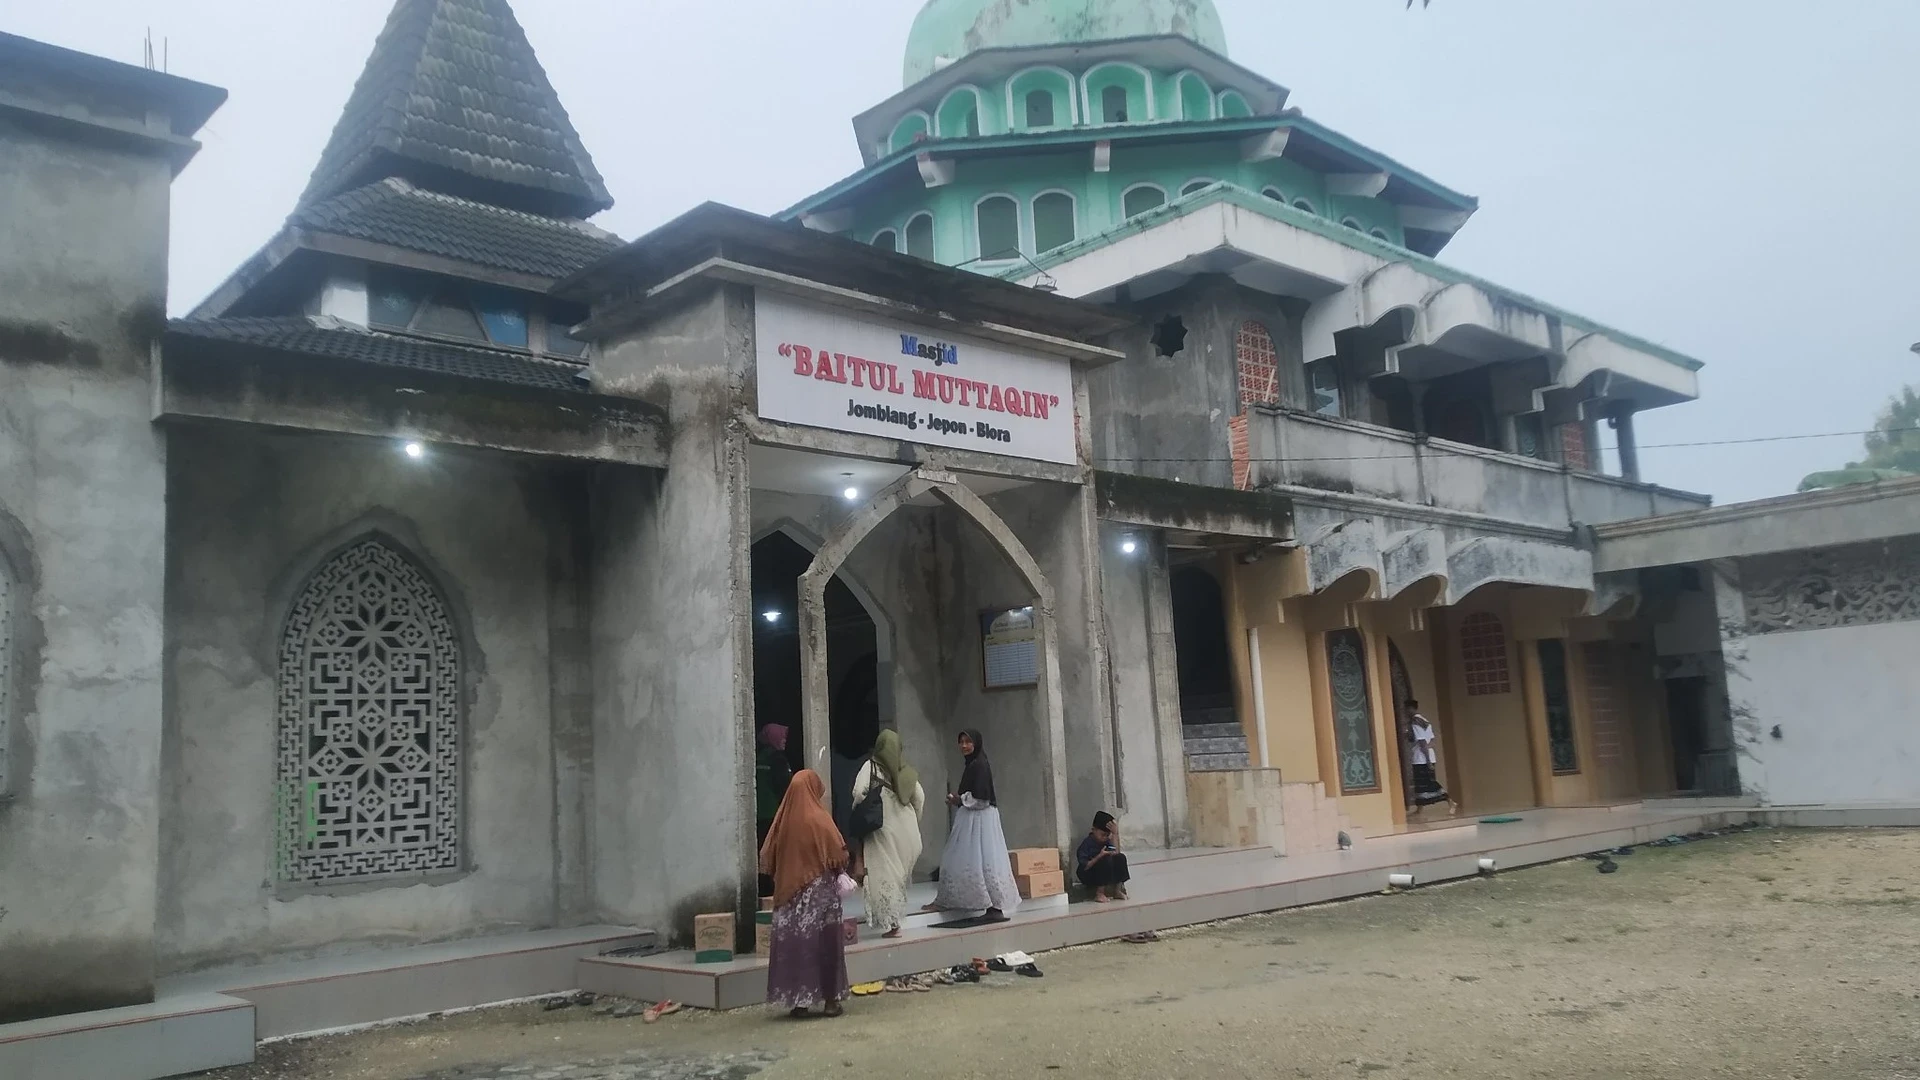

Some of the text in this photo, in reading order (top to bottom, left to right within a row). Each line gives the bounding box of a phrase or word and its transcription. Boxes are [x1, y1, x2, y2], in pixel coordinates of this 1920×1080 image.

[900, 334, 959, 367] Masjid
[847, 399, 918, 430] Jomblang
[927, 413, 967, 436] Jepon
[976, 421, 1011, 443] Blora
